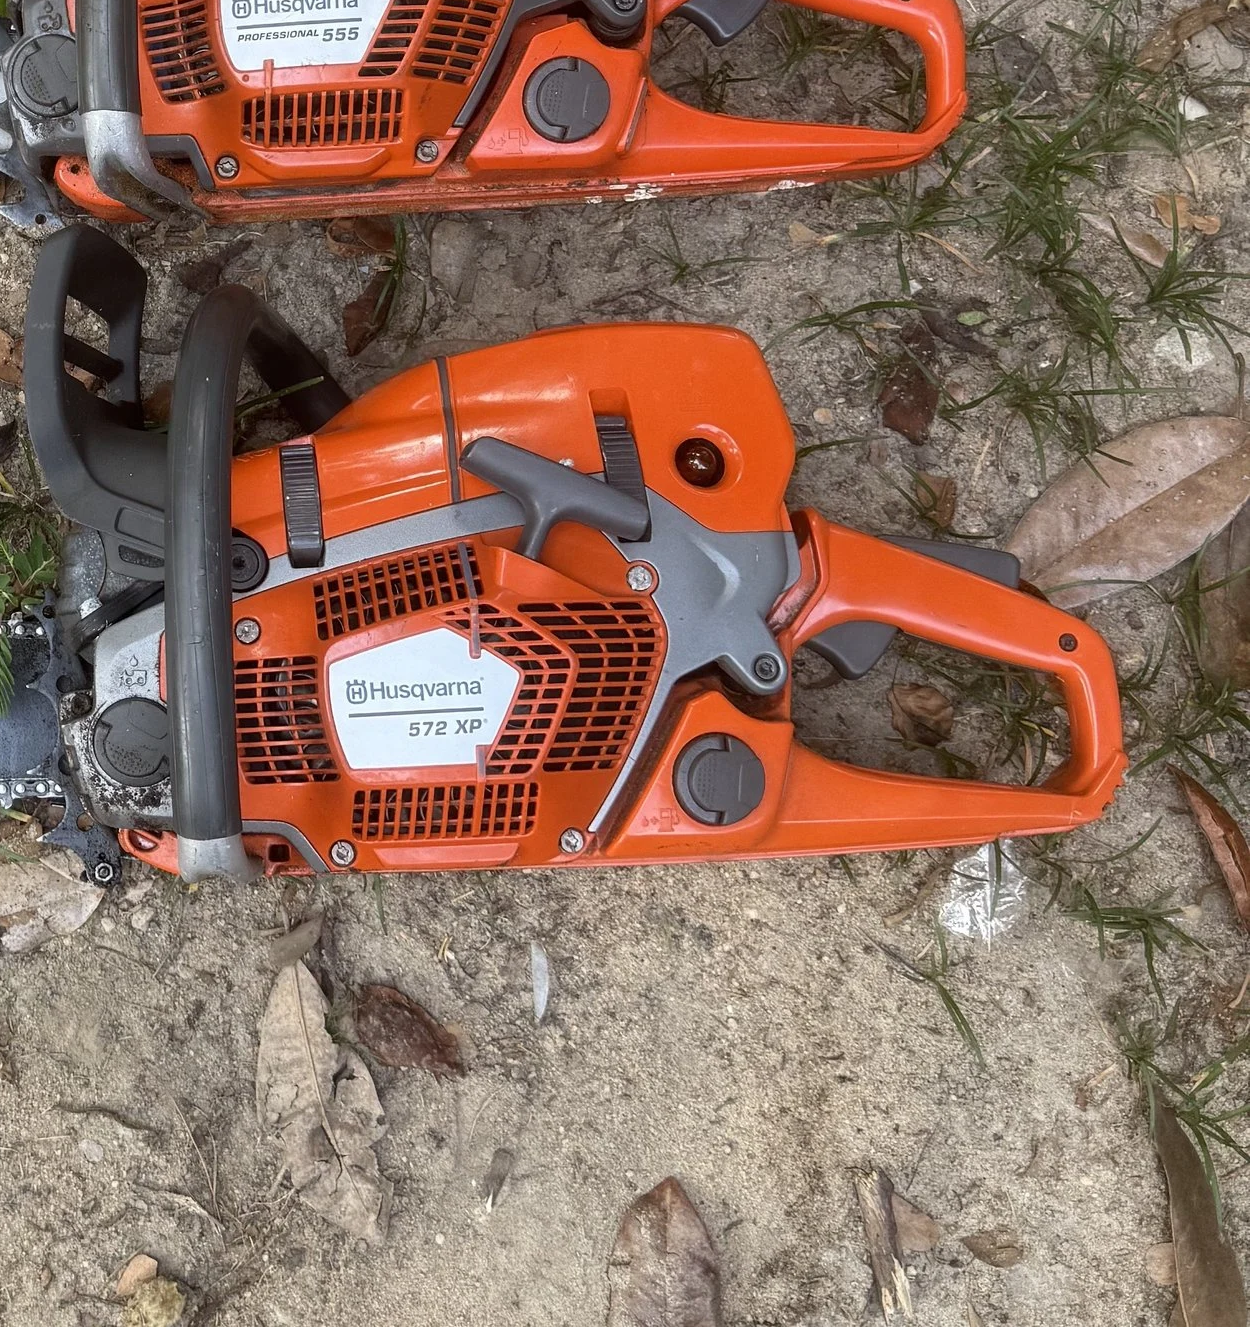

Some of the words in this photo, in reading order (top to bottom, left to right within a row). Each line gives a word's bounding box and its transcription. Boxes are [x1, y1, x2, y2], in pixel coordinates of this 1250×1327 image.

[237, 29, 319, 42] PROFESSIONAL
[322, 27, 360, 42] 555
[370, 680, 482, 701] Husqvarna
[408, 721, 448, 737] 572
